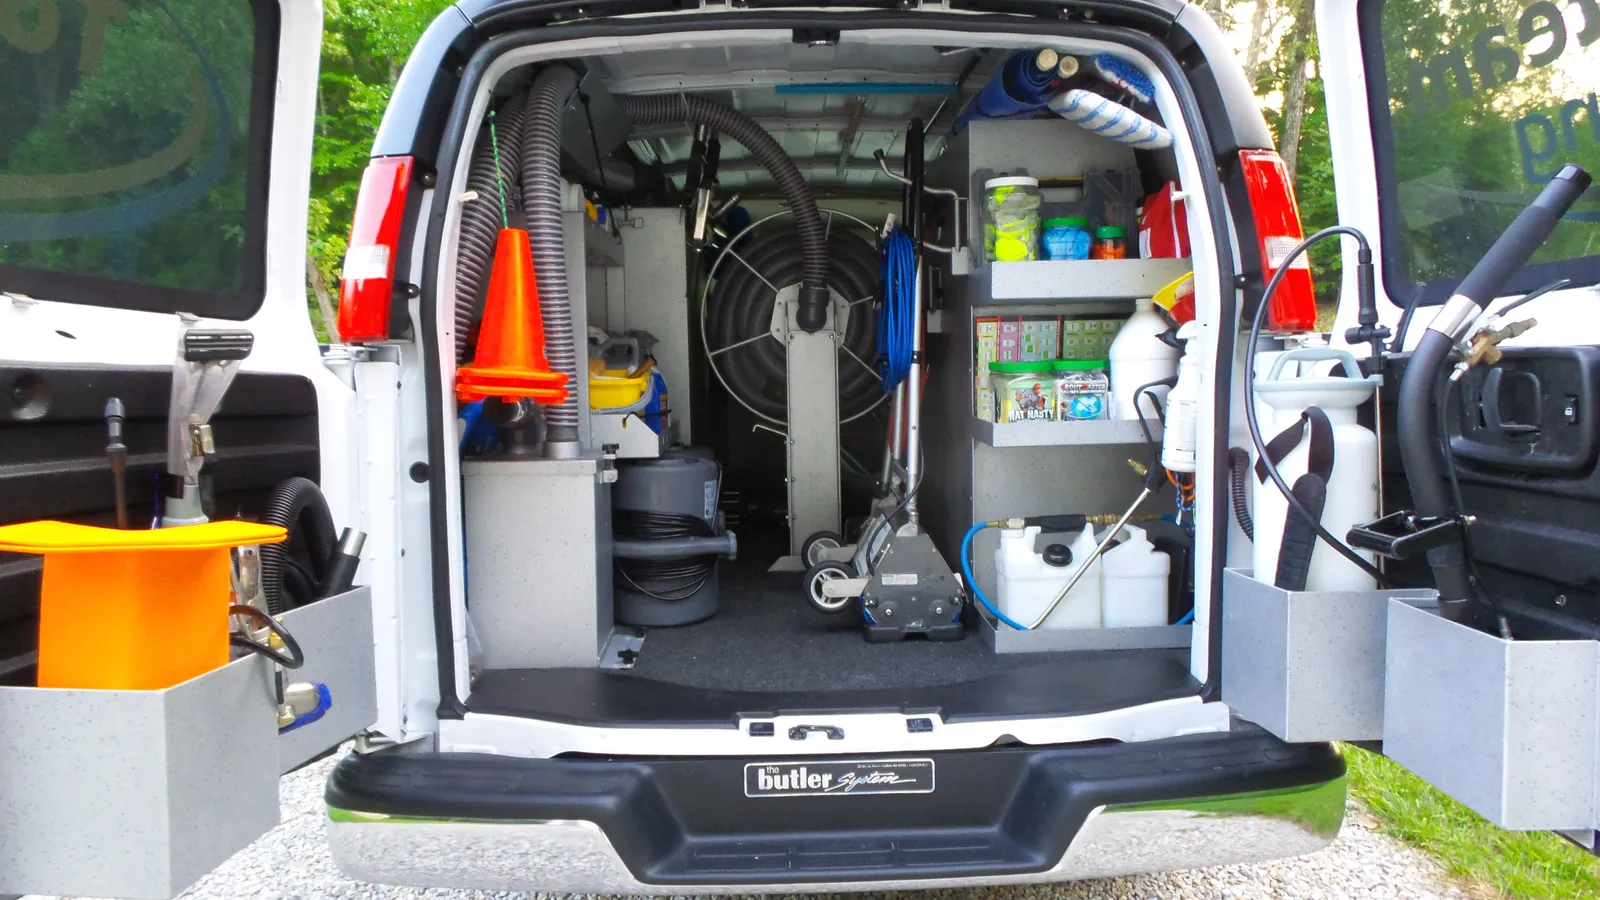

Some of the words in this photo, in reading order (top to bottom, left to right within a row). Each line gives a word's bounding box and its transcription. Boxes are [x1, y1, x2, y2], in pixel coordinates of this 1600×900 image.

[1008, 410, 1024, 421] RAT
[1027, 408, 1054, 419] NASTY
[766, 766, 779, 774] the
[758, 767, 832, 790] butler
[826, 771, 916, 792] System
